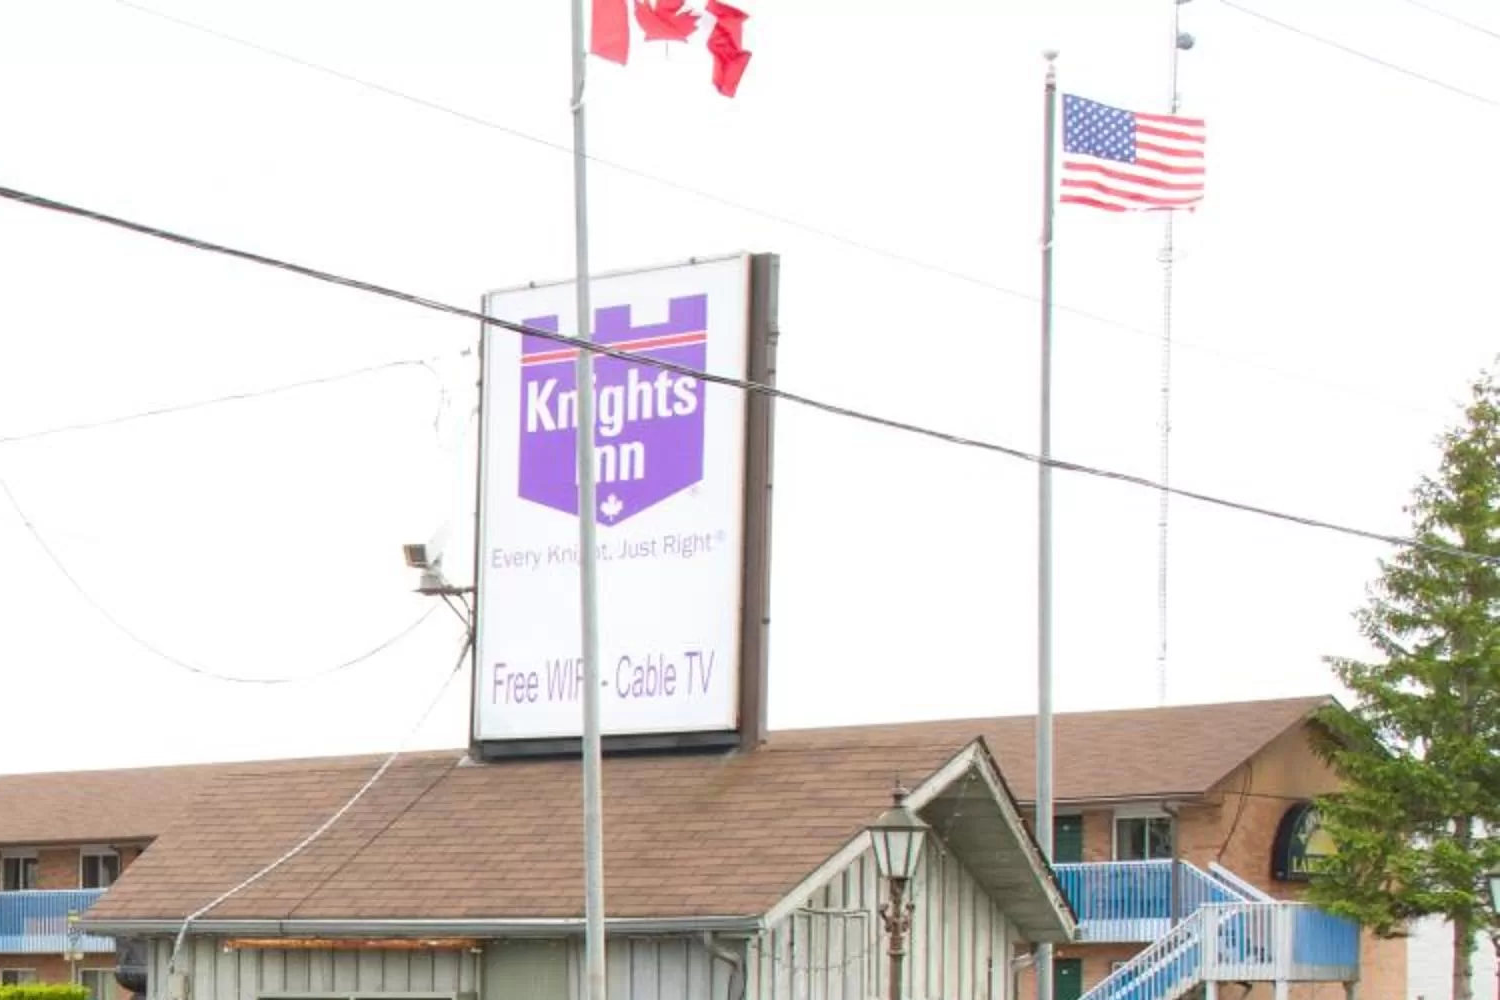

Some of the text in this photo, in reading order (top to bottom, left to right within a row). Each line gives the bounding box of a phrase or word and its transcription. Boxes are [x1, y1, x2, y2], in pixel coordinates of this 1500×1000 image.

[576, 440, 645, 484] nn
[491, 548, 542, 570] Every
[617, 538, 657, 560] Just
[492, 661, 540, 705] Free
[546, 657, 594, 702] WIF
[615, 653, 677, 699] Cable
[684, 650, 715, 696] TV
